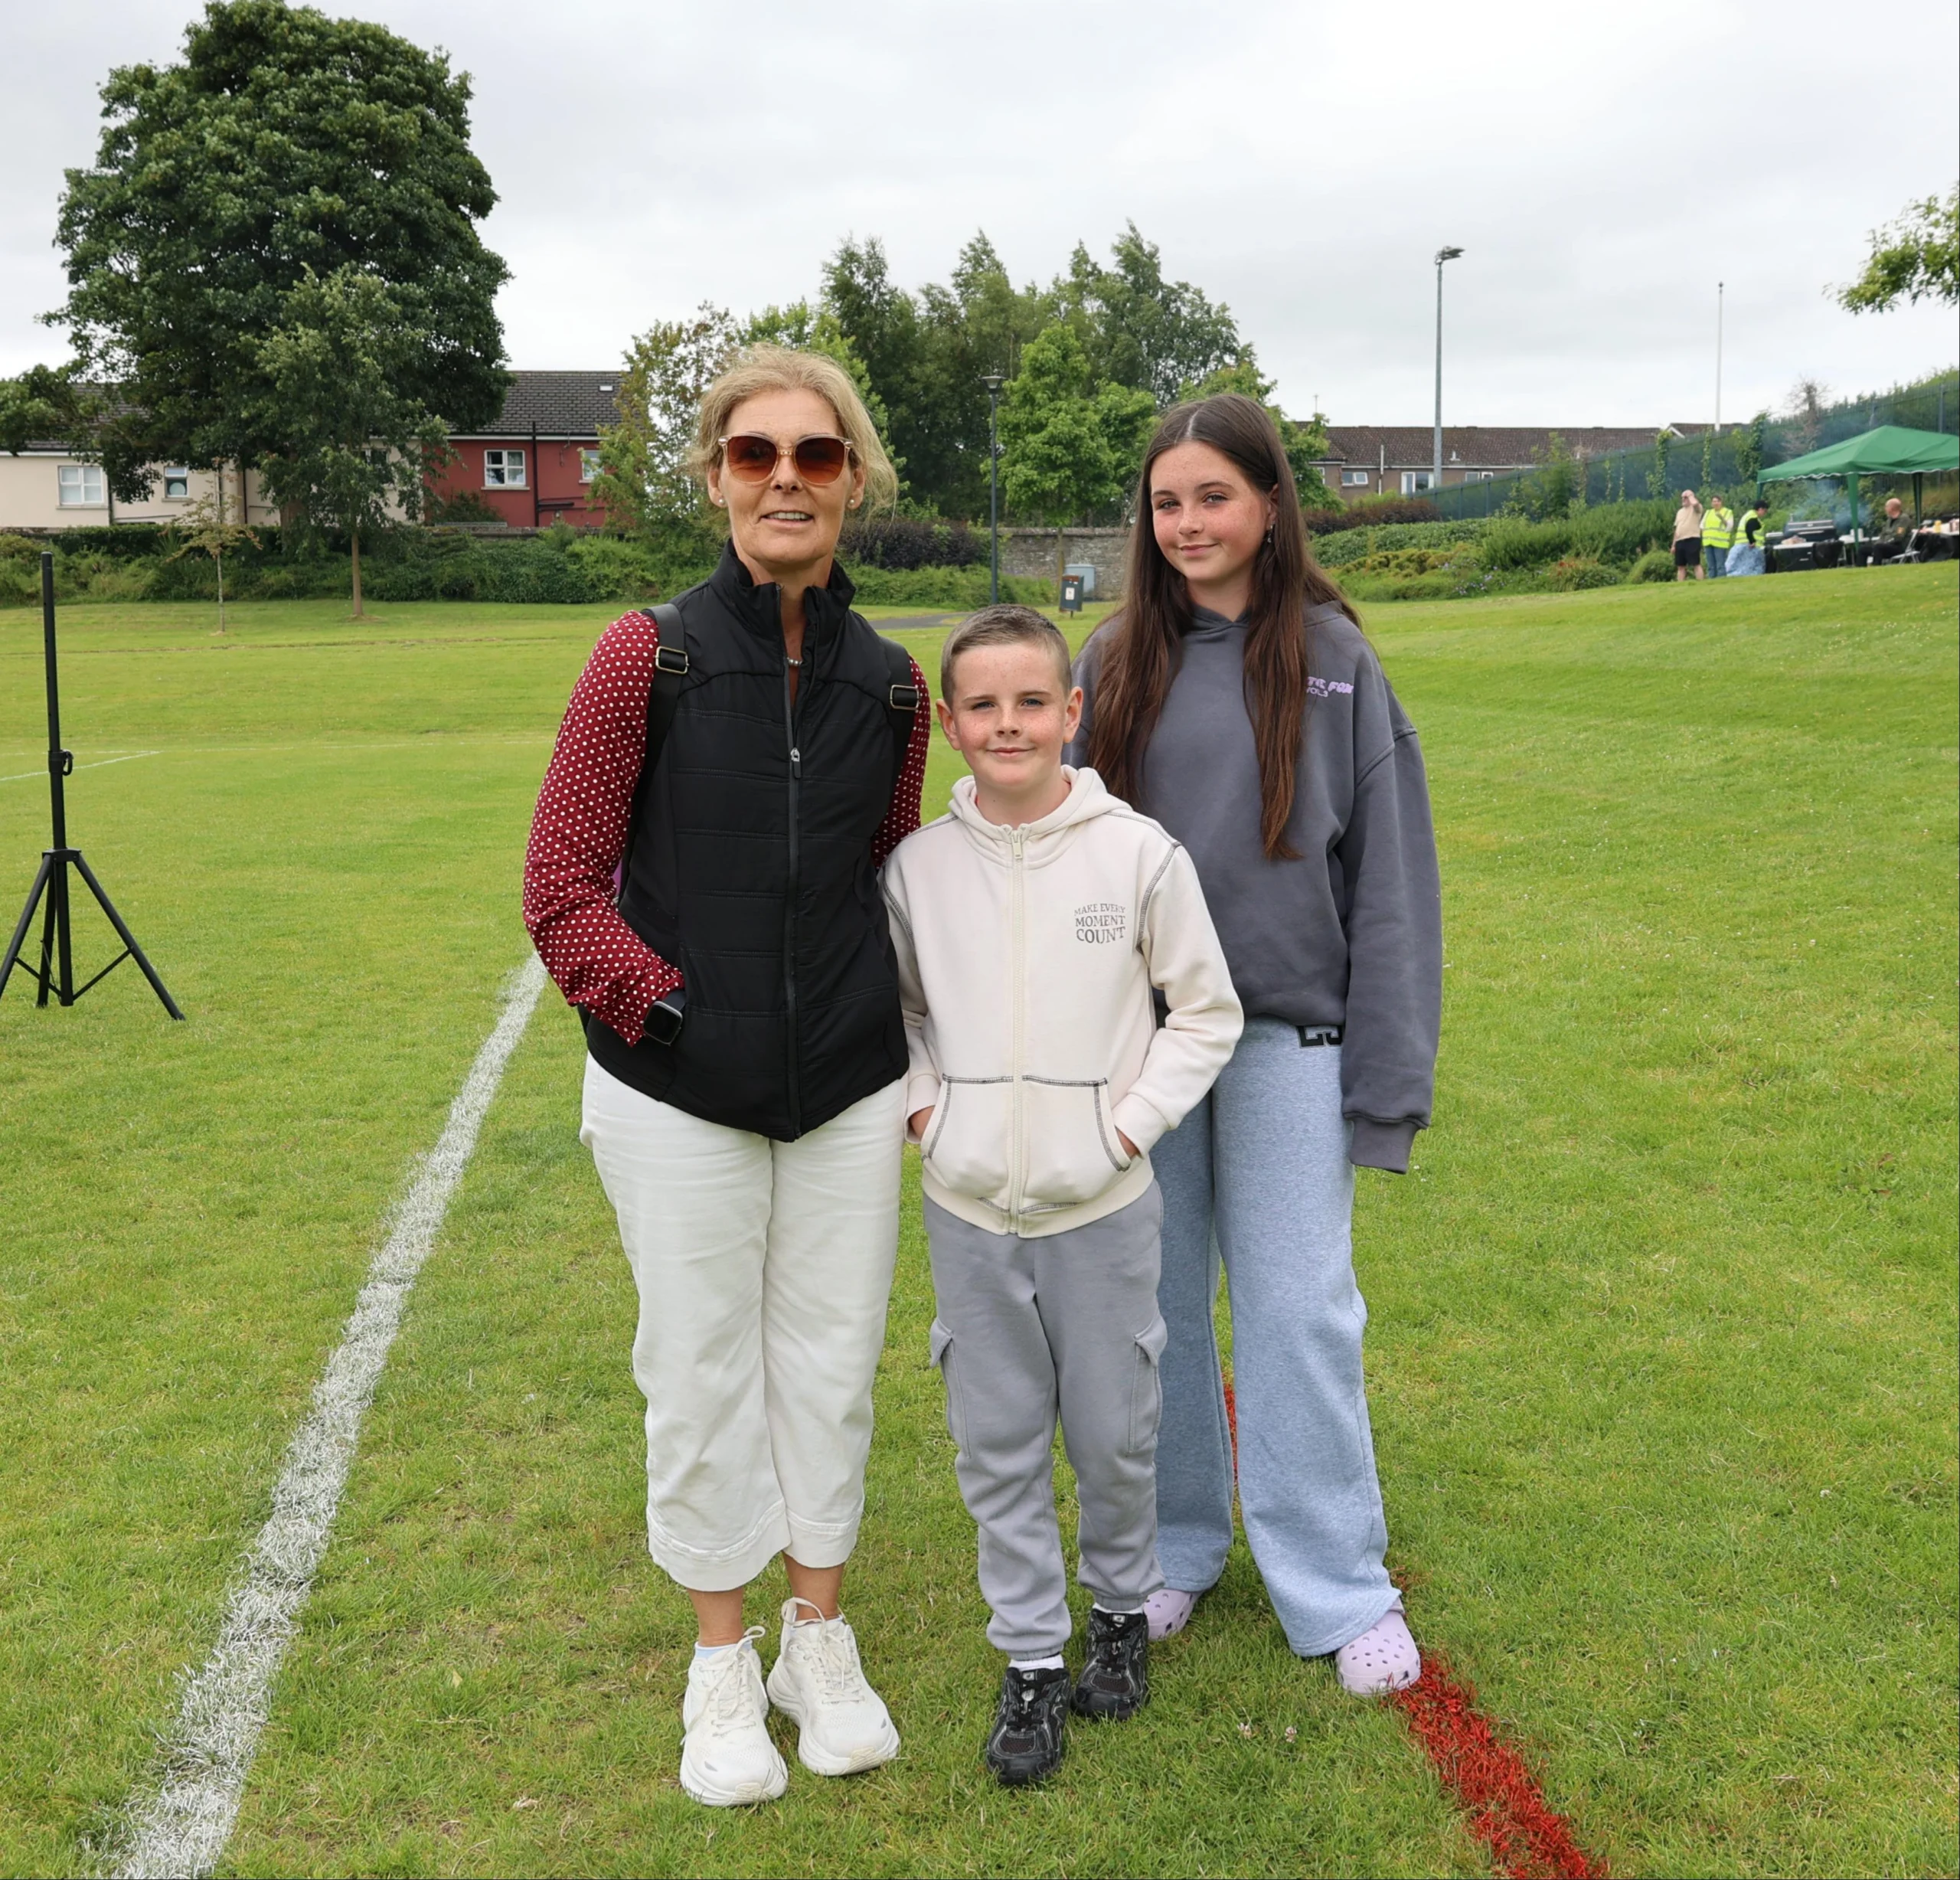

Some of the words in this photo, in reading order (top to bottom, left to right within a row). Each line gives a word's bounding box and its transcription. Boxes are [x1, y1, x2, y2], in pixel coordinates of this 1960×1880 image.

[1074, 904, 1099, 916] MAKE
[1100, 904, 1125, 913] EVERY
[1075, 915, 1125, 927] MOMENT
[1076, 927, 1125, 943] COUNT
